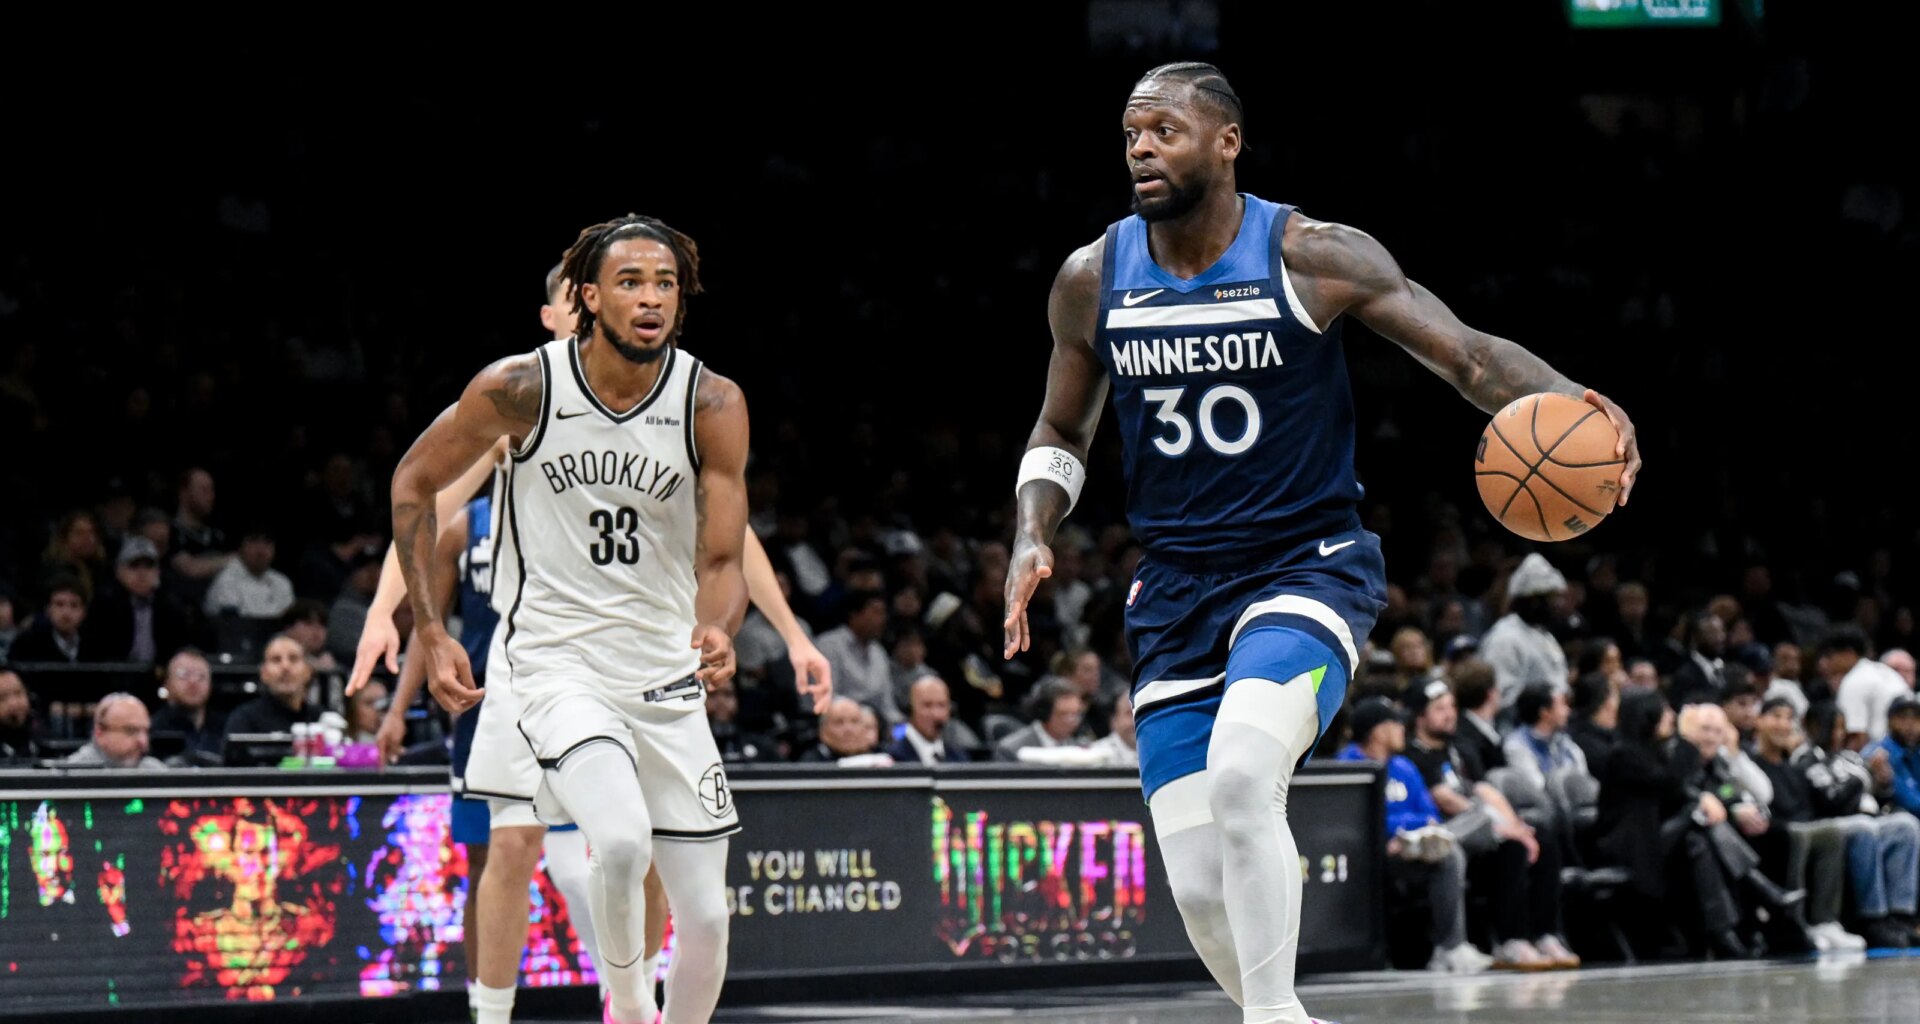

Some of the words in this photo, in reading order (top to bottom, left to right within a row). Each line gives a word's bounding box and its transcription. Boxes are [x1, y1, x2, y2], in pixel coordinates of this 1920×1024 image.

[1222, 285, 1260, 298] sezzle
[1111, 331, 1283, 376] MINNESOTA
[645, 415, 655, 425] All
[656, 416, 664, 426] In
[1143, 384, 1261, 456] 30
[540, 450, 686, 502] BROOKLYN
[1050, 456, 1073, 476] 30
[589, 506, 640, 566] 33
[746, 850, 805, 881] YOU
[814, 849, 877, 878] WILL
[764, 880, 902, 916] CHANGED
